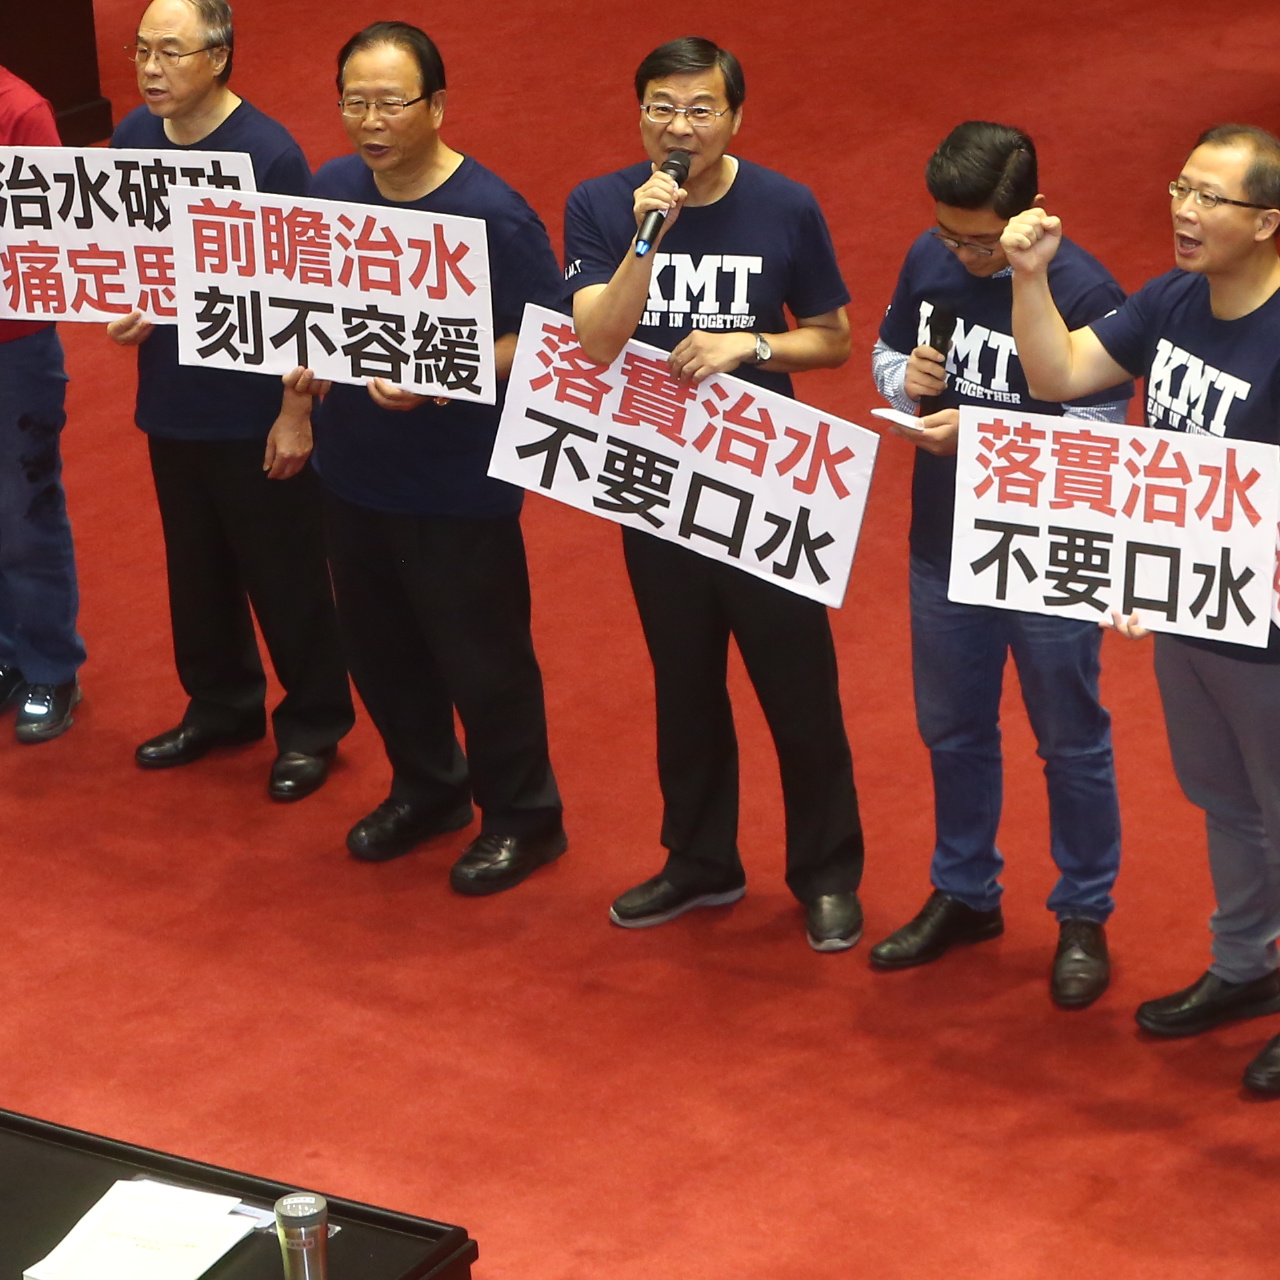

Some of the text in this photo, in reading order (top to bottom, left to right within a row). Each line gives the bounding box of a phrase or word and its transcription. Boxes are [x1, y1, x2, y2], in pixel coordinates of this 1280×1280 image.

[187, 198, 477, 300] 前瞻治水
[194, 286, 482, 395] 刻不容緩
[669, 313, 684, 328] IN
[691, 313, 756, 329] TOGETHER
[529, 323, 855, 500] 落實治水
[955, 378, 1021, 404] TOGETHER
[1148, 338, 1252, 438] KMT
[515, 408, 835, 585] 不要口水
[973, 418, 1262, 532] 落實治水
[970, 518, 1256, 631] 不要口水
